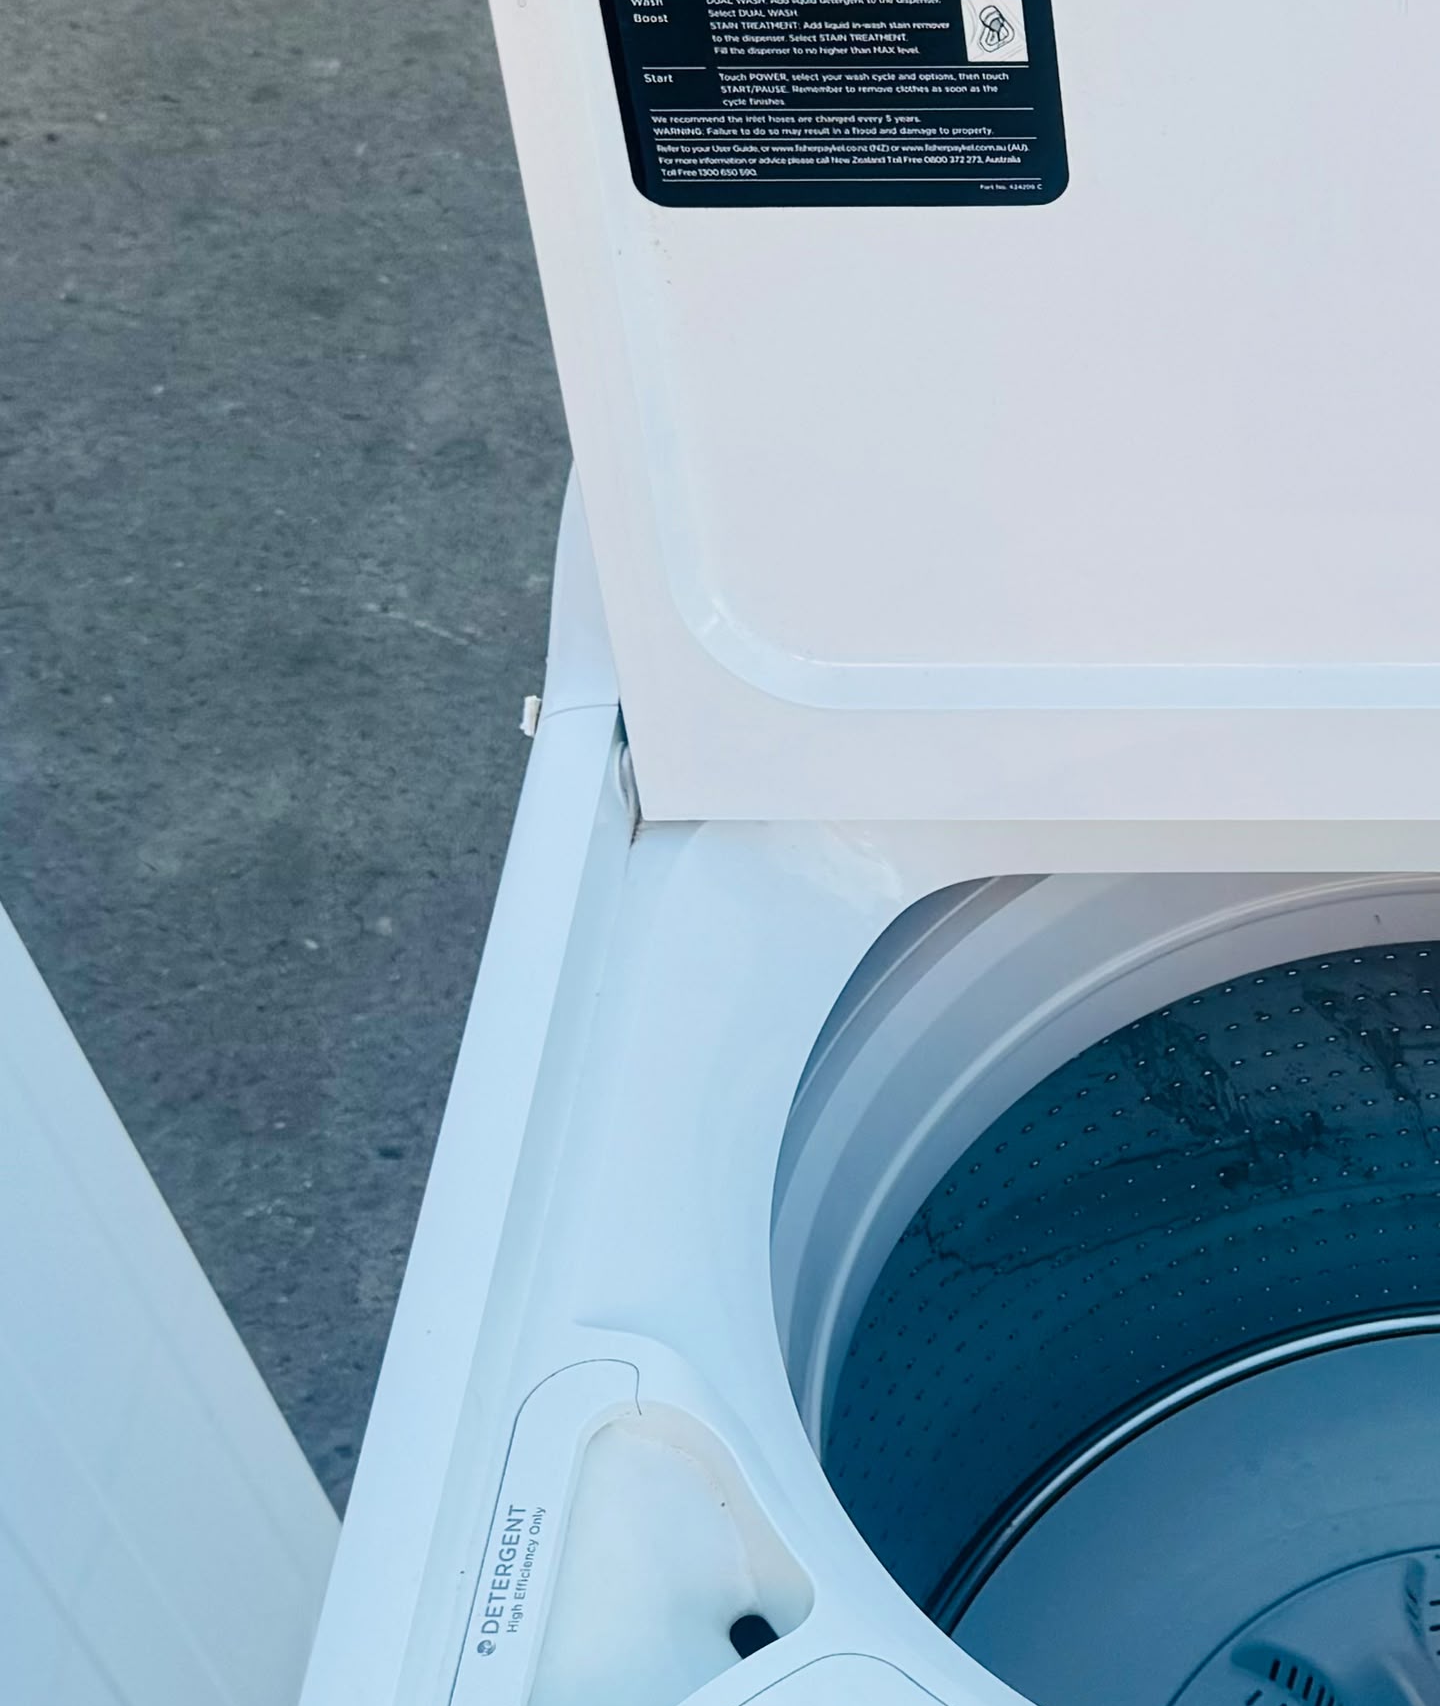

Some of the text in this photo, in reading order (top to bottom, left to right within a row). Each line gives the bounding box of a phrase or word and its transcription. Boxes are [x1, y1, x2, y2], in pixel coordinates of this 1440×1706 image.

[633, 13, 669, 23] Boost
[643, 73, 674, 83] Start
[481, 1504, 527, 1634] DETERGENT
[506, 1506, 546, 1633] High Efficiency Only
